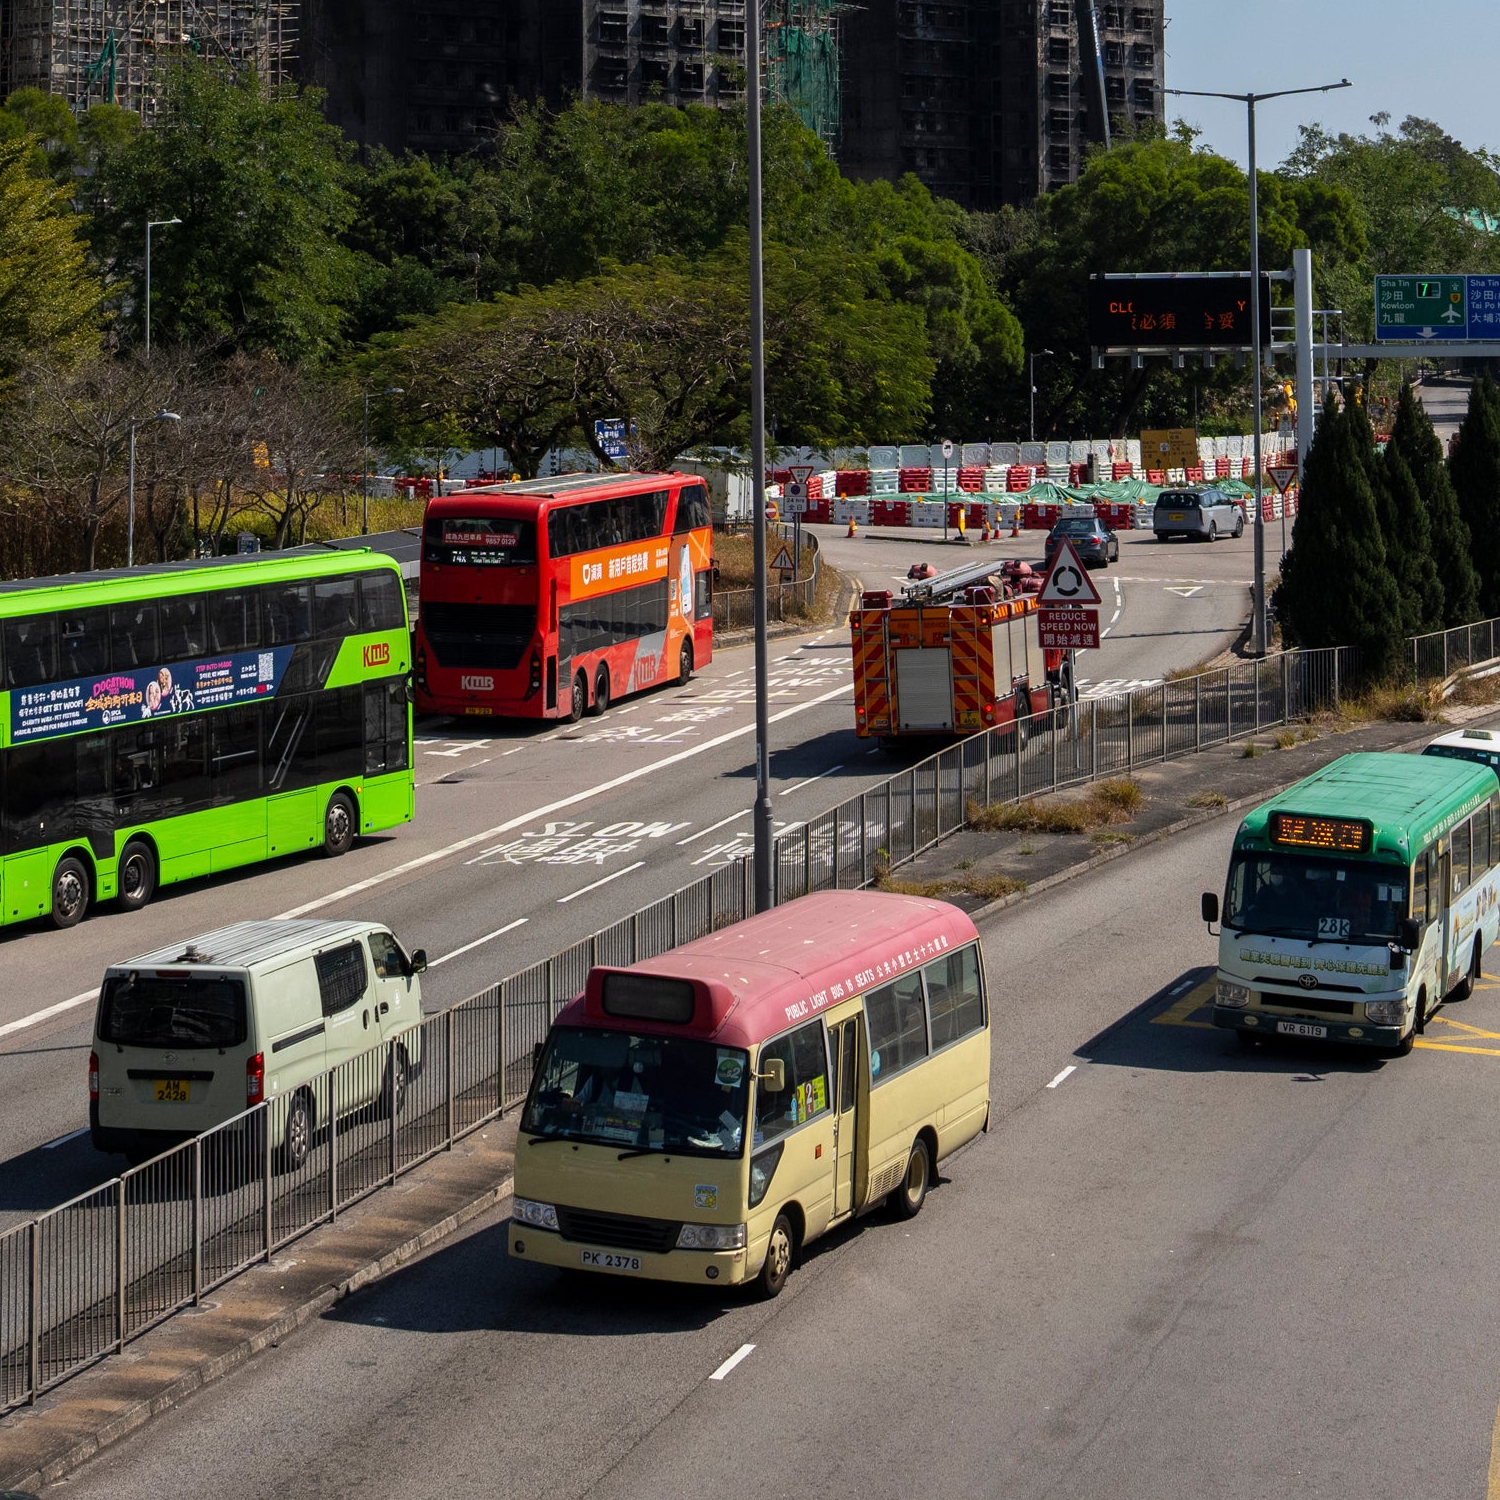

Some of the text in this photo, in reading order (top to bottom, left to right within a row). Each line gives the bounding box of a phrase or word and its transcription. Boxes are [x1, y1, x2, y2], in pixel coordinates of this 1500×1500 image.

[1381, 279, 1410, 287] Sha Tin
[1470, 279, 1486, 287] Sha
[1488, 279, 1500, 287] Tin
[1381, 290, 1404, 300] 沙田
[1421, 283, 1428, 297] 7
[1381, 302, 1415, 310] Kowloon
[1471, 302, 1495, 310] Tai Po
[1381, 313, 1406, 323] 九龍
[1049, 612, 1087, 621] REDUCE
[1040, 622, 1097, 631] SPEED NOW
[1043, 633, 1095, 646] 開始減速
[362, 642, 391, 668] KMB
[461, 675, 495, 691] KMB
[521, 821, 693, 838] SLOW
[1319, 918, 1350, 937] 28K
[785, 1000, 808, 1021] PUBLIC
[809, 990, 829, 1010] LIGHT
[830, 983, 845, 1000] BUS
[847, 979, 854, 992] 16
[855, 968, 875, 988] SEATS
[1283, 1023, 1322, 1036] VR 6119
[165, 1080, 181, 1091] AM
[157, 1090, 187, 1101] 2428
[583, 1251, 640, 1270] PK 2378
